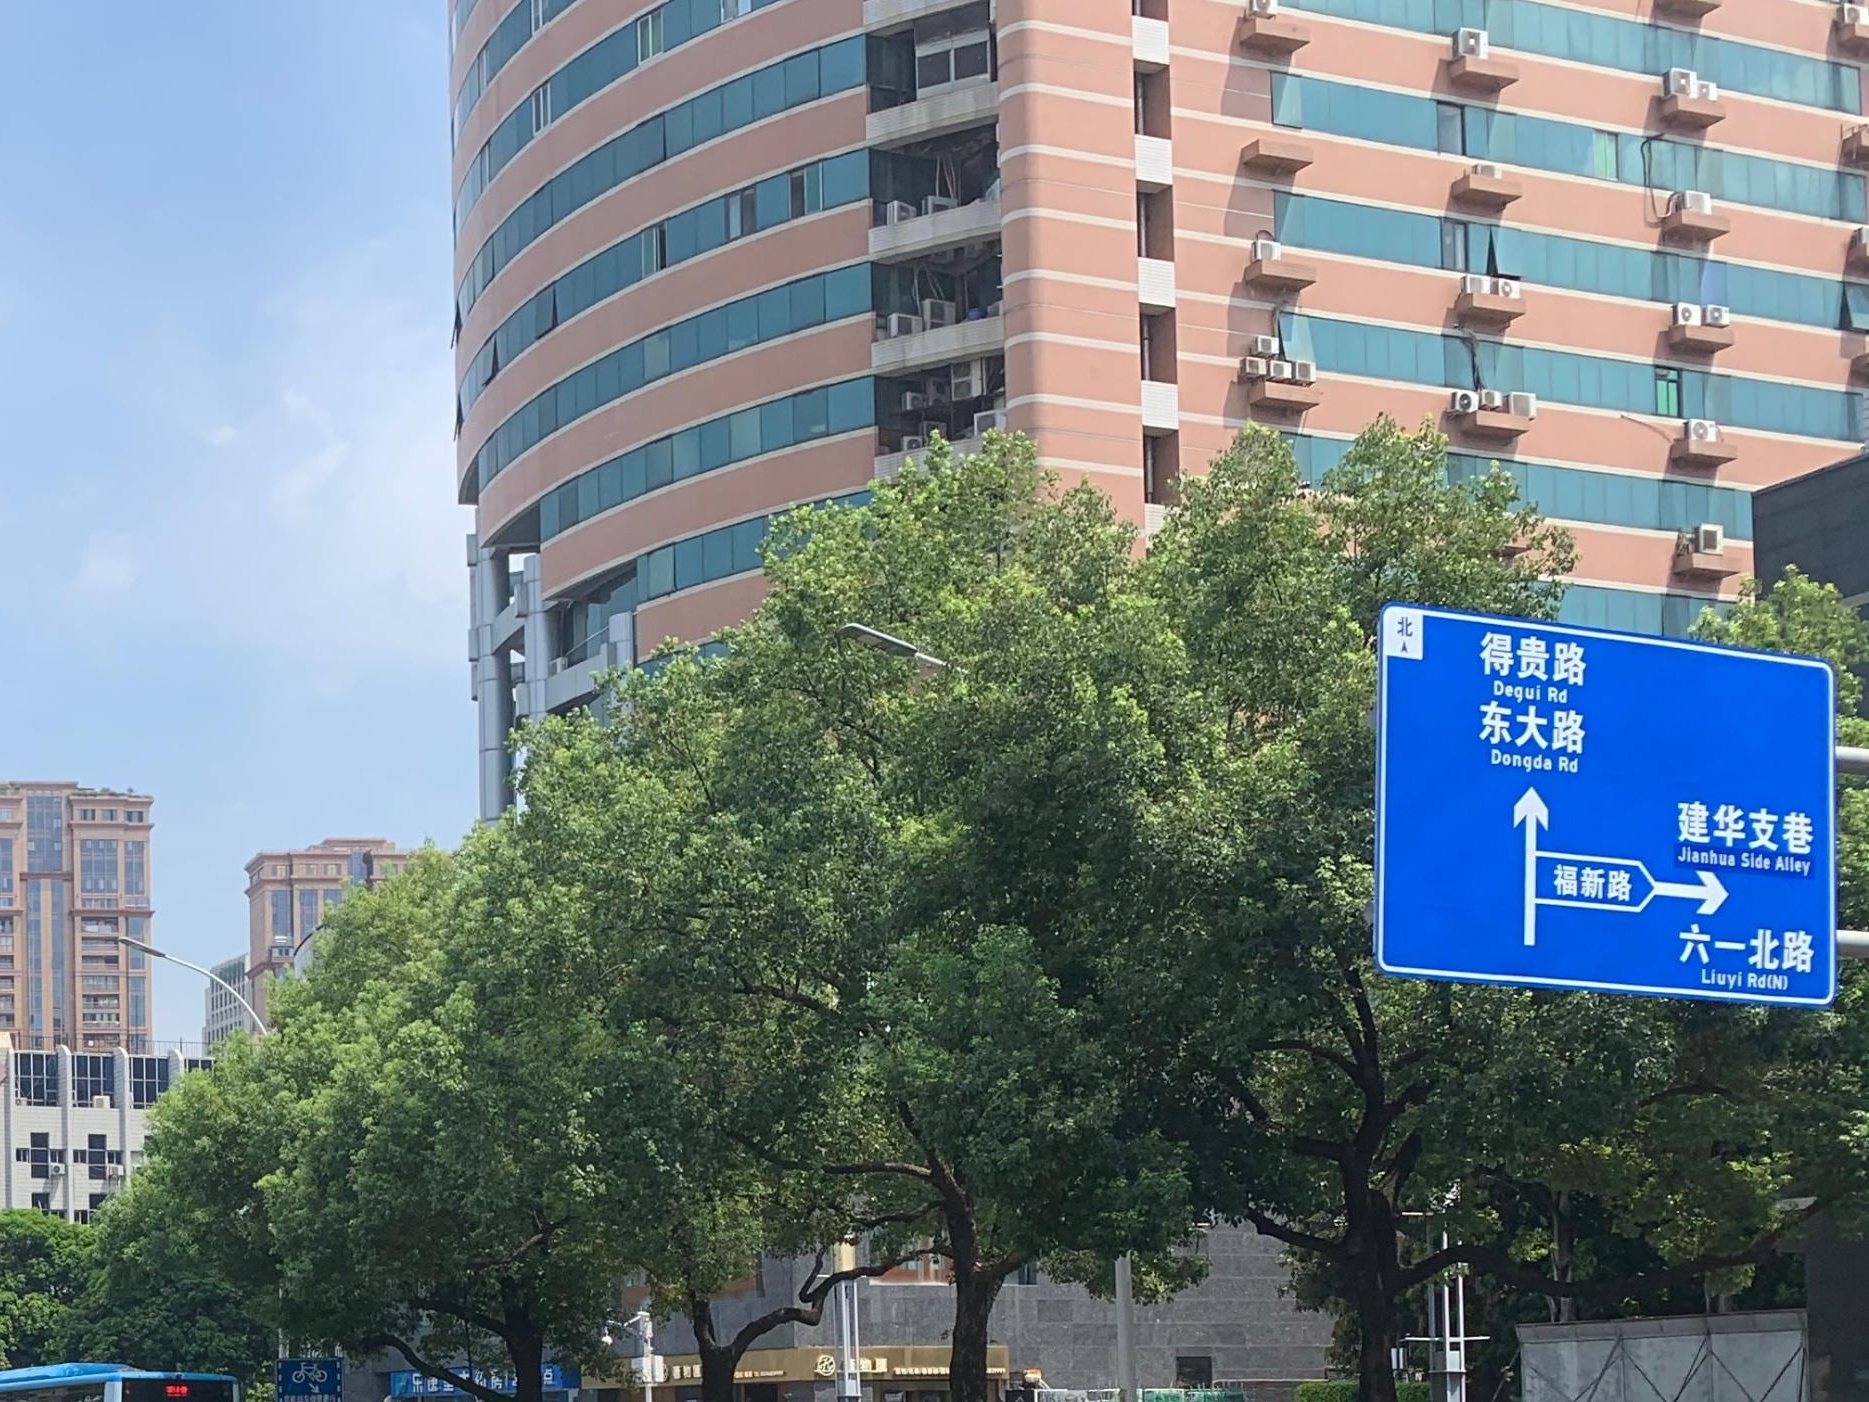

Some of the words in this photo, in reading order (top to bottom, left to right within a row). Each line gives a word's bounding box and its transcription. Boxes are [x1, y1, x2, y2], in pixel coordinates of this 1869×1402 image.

[1397, 616, 1413, 637] 北
[1480, 631, 1587, 687] 得贵路
[1493, 680, 1541, 704] Degui
[1548, 685, 1568, 704] Rd
[1479, 700, 1586, 754] 东大路
[1491, 748, 1552, 773] Dongda
[1558, 755, 1579, 774] Rd
[1677, 801, 1814, 856] 建华支巷
[1678, 846, 1735, 869] Jianhua
[1741, 853, 1771, 872] Side
[1775, 856, 1811, 877] Alley
[1553, 863, 1633, 903] 福新路
[1679, 924, 1816, 974] 六一北路
[1702, 968, 1743, 991] Liuyi
[1747, 973, 1789, 992] Rd(N)
